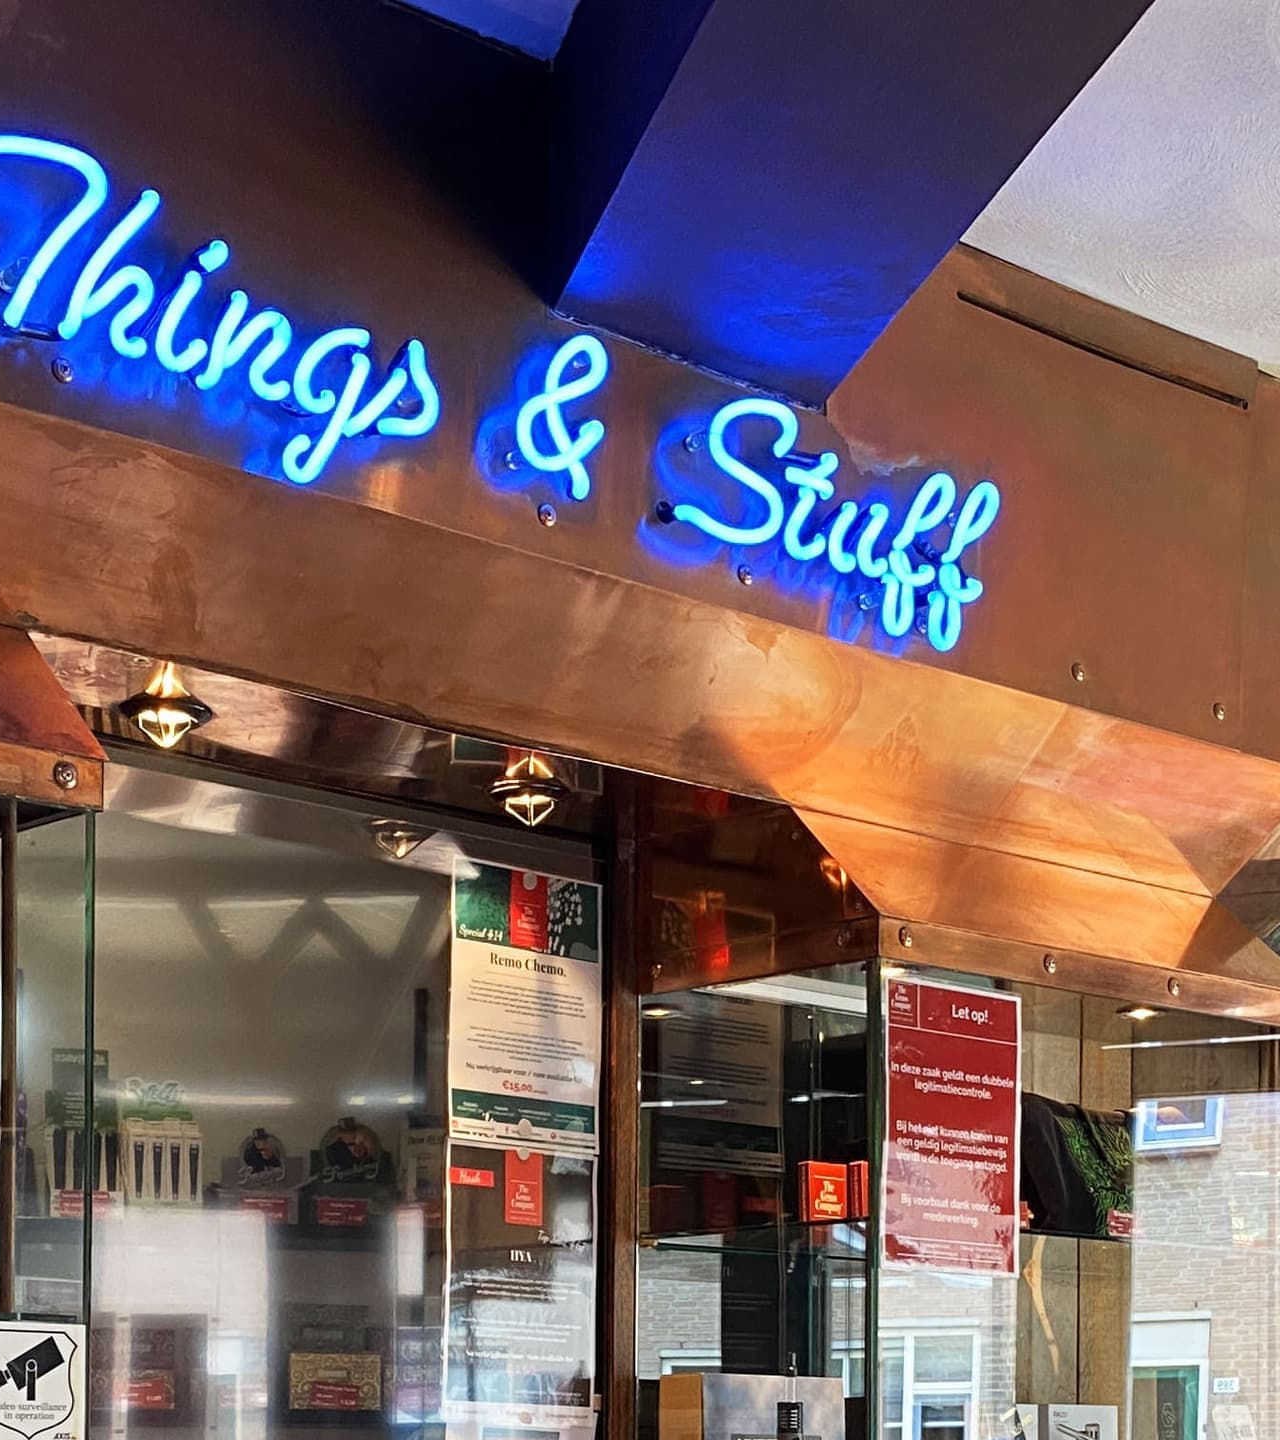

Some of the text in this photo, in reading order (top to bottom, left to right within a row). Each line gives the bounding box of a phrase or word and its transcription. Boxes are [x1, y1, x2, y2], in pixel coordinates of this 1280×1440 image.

[515, 332, 609, 500] &
[671, 397, 1002, 653] Stuff
[459, 923, 486, 938] Special
[490, 952, 567, 977] Remo Chemo.
[951, 1004, 988, 1025] Let op!
[891, 1061, 1014, 1088] In deze zaak geldt een dubbele
[896, 1120, 907, 1133] Bij
[994, 1135, 1008, 1144] van
[896, 1137, 1007, 1160] een geldig legitimatiebewijs
[940, 1156, 973, 1171] toegang
[823, 1180, 835, 1192] The
[901, 1193, 912, 1207] Bij
[950, 1199, 969, 1210] dank
[971, 1203, 990, 1212] voor
[991, 1203, 1001, 1214] de
[15, 1412, 54, 1421] operation
[18, 1402, 67, 1412] surveillance
